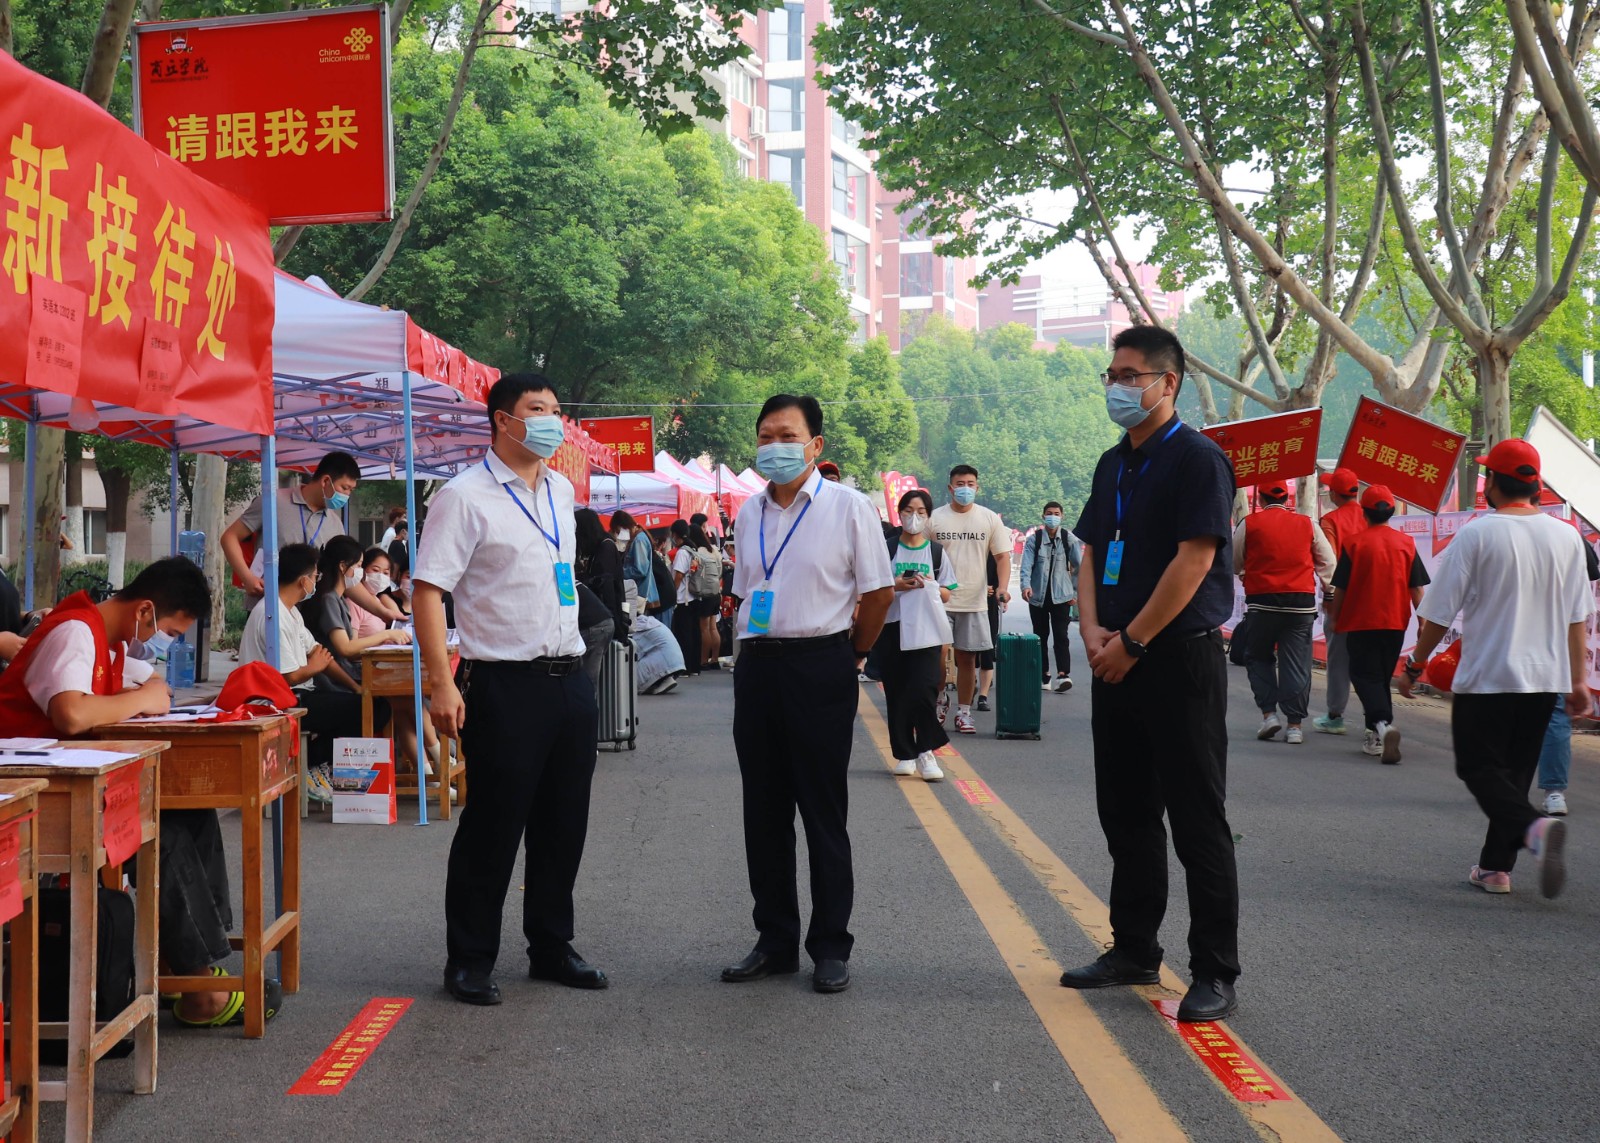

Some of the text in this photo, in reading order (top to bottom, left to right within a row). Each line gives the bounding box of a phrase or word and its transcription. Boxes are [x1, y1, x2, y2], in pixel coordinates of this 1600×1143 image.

[320, 55, 346, 63] unicom
[165, 105, 359, 163] 请跟我来
[2, 122, 237, 362] 新接待处
[1234, 458, 1279, 478] 学院
[1357, 436, 1440, 484] 请跟我来
[936, 532, 986, 541] ESSENTIALS
